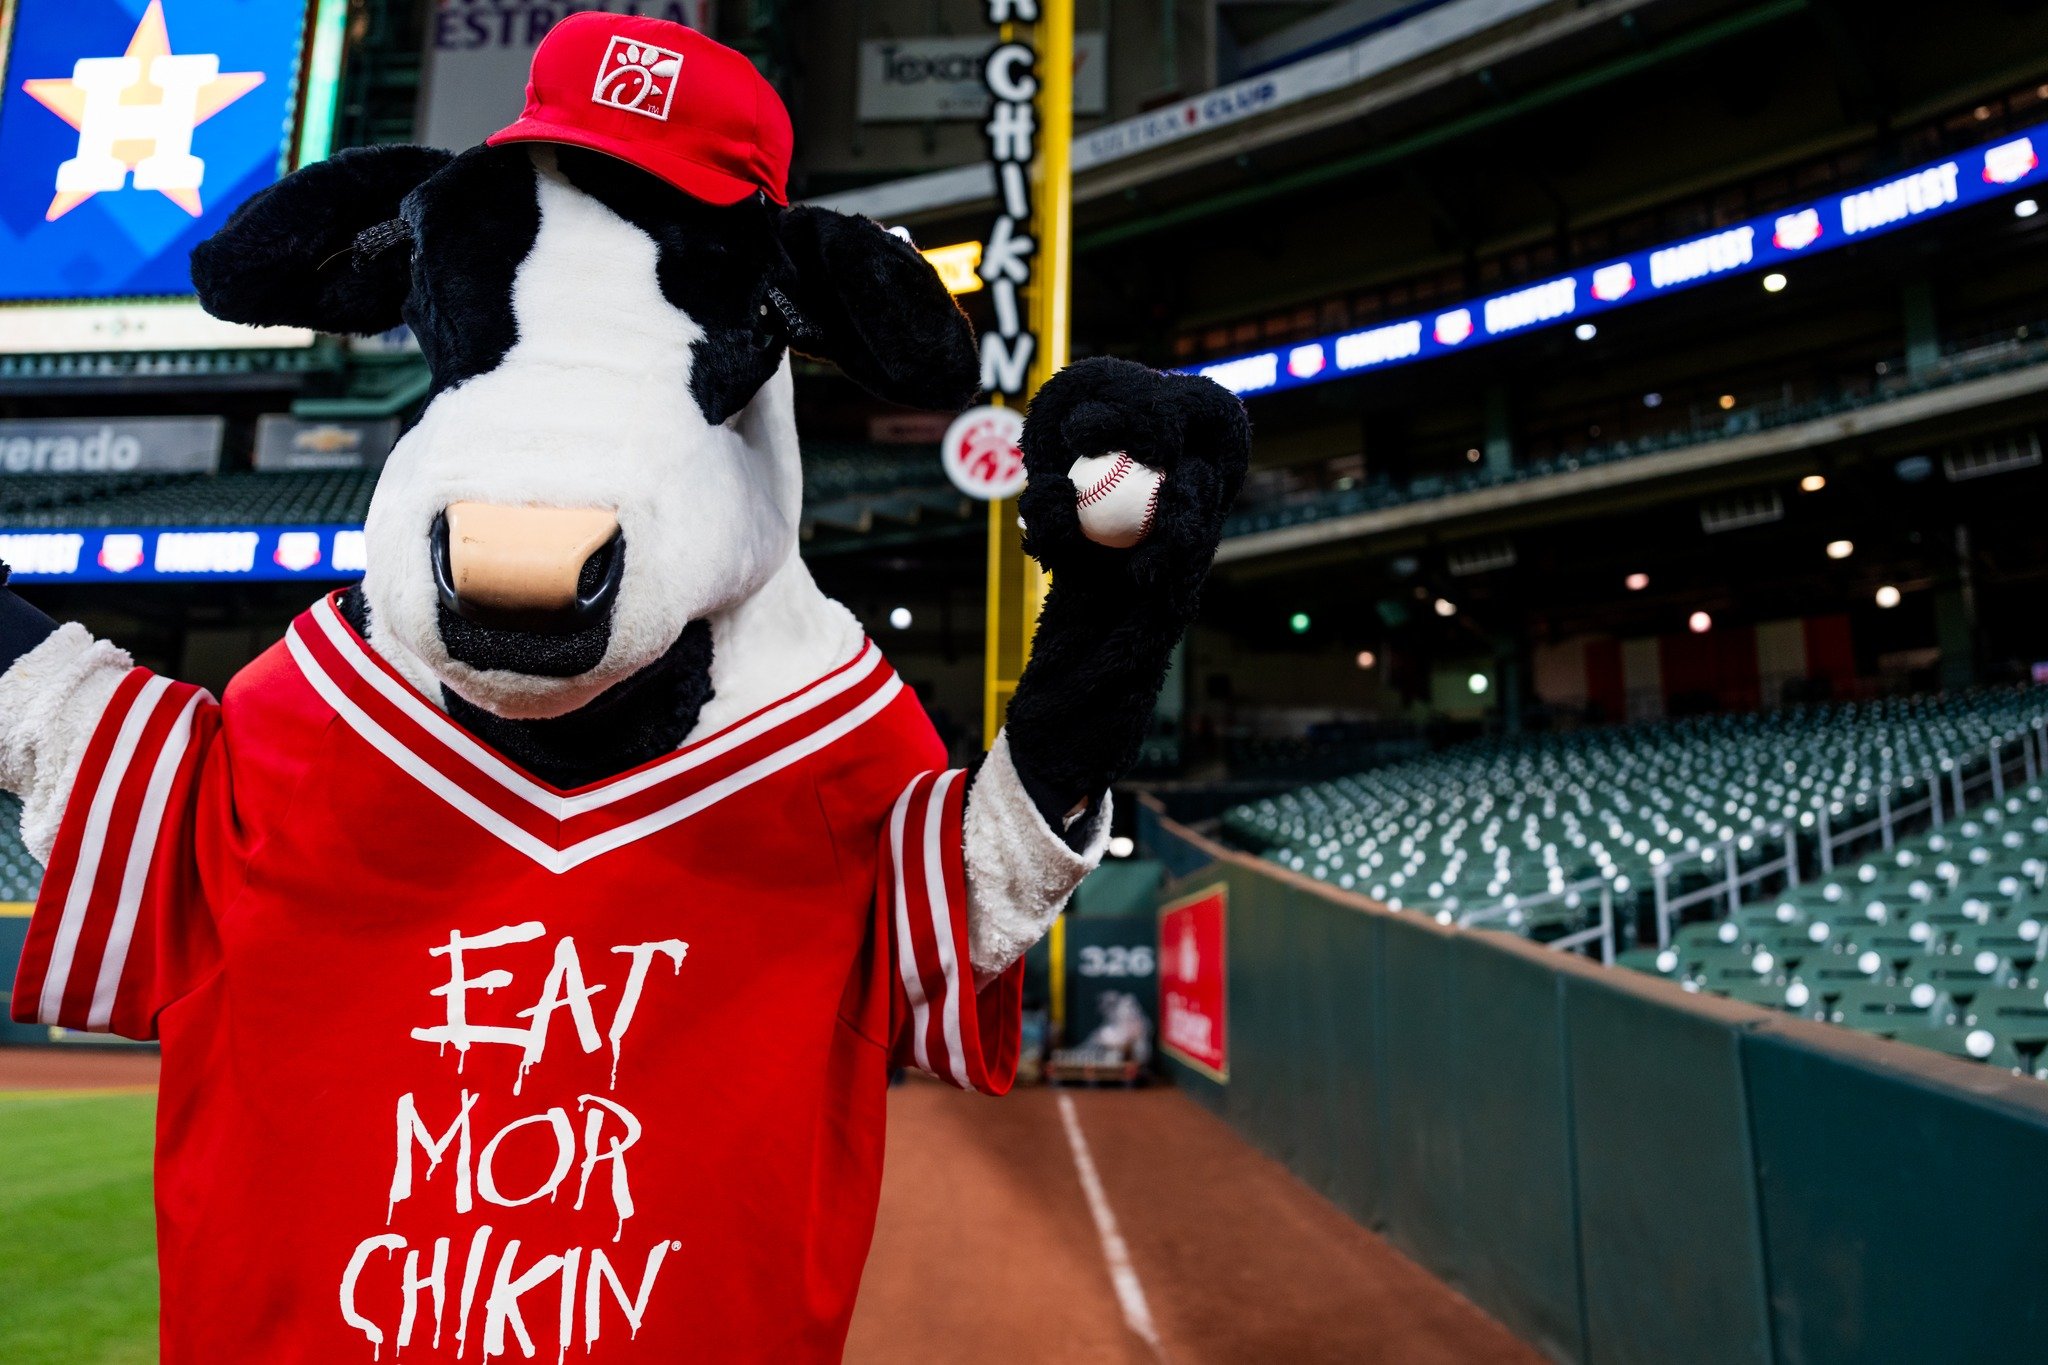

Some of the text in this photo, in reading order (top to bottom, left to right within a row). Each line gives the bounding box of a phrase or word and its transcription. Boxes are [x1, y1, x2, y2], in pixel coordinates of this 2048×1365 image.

[433, 8, 692, 48] ESTRA
[979, 44, 1036, 393] CHIKIN
[410, 921, 690, 1096] EAT
[1078, 945, 1155, 977] 326
[386, 1089, 642, 1243] MOR
